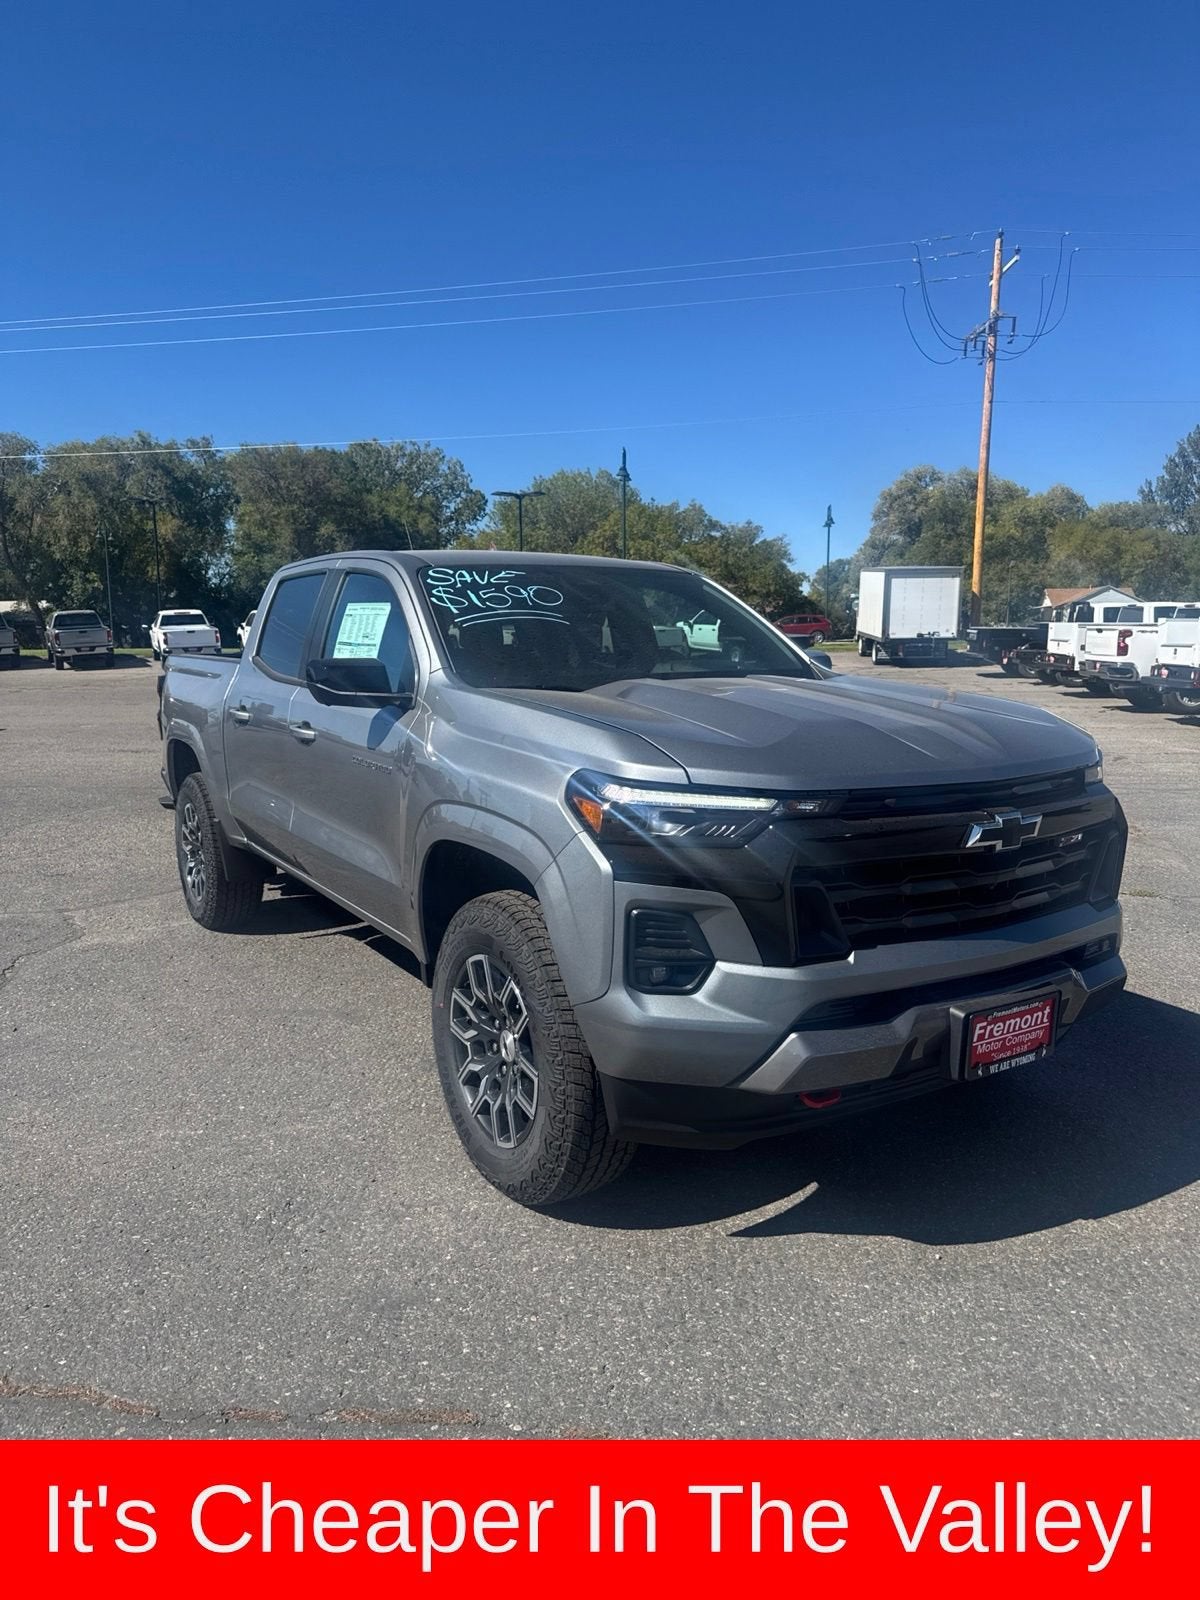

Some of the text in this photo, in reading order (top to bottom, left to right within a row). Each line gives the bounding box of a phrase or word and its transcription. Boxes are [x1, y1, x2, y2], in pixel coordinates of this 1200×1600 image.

[427, 567, 527, 588] SAVE
[430, 585, 564, 614] $1590
[973, 1006, 1051, 1042] Fremont
[976, 1028, 1045, 1055] Motor Company
[989, 1053, 1036, 1075] WE ARE WYOMING
